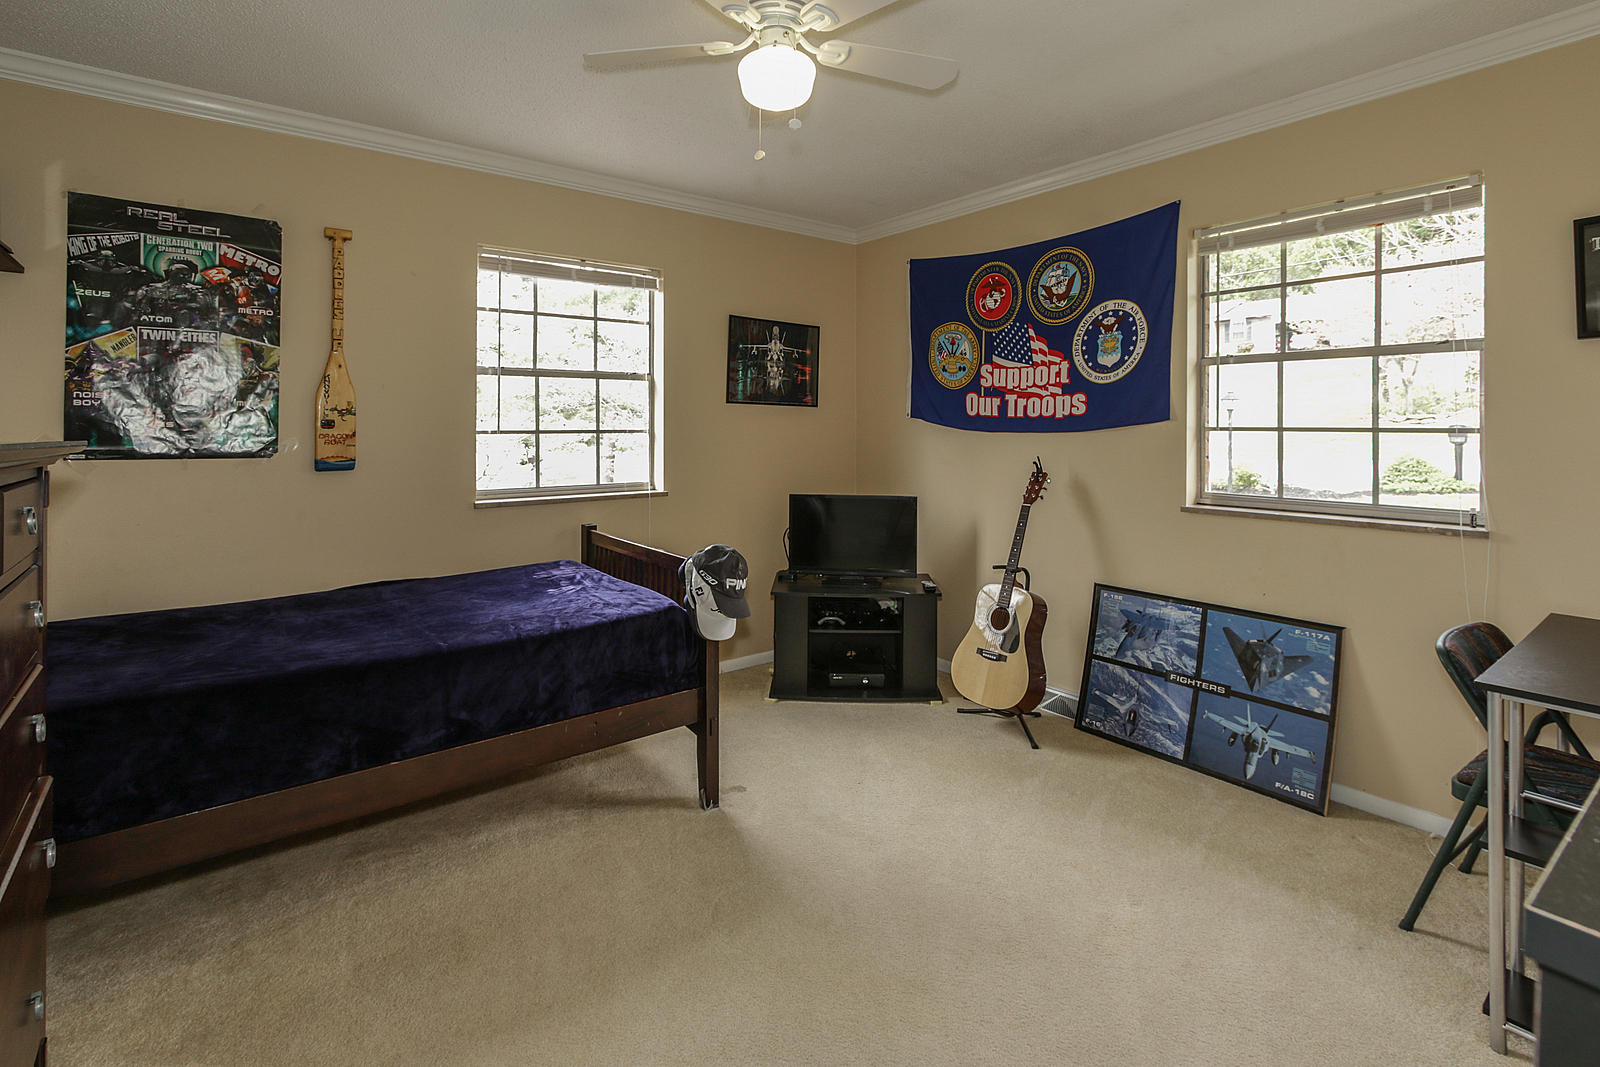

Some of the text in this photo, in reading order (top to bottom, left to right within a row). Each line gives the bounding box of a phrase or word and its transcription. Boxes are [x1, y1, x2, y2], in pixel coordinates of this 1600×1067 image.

[127, 206, 189, 223] REAL
[158, 220, 231, 238] STEEL
[67, 236, 89, 257] KING
[86, 236, 98, 252] OF
[97, 235, 113, 247] THE
[146, 234, 213, 251] GENERATION TWO
[220, 245, 280, 276] METRO
[75, 288, 111, 298] ZEUS
[140, 315, 173, 323] ATOM
[238, 307, 274, 316] METRO
[141, 329, 216, 343] TWIN CITIES
[1075, 311, 1097, 357] DEPARTMENT
[1099, 303, 1109, 311] OF
[1128, 306, 1140, 315] AIR
[1137, 317, 1146, 343] FORCE
[980, 360, 1070, 389] Support
[1079, 362, 1093, 378] UNITED
[73, 391, 111, 399] NOIS
[965, 392, 1087, 418] Our Troops
[1295, 629, 1331, 641] F-117A
[1170, 674, 1226, 694] FIGHTERS
